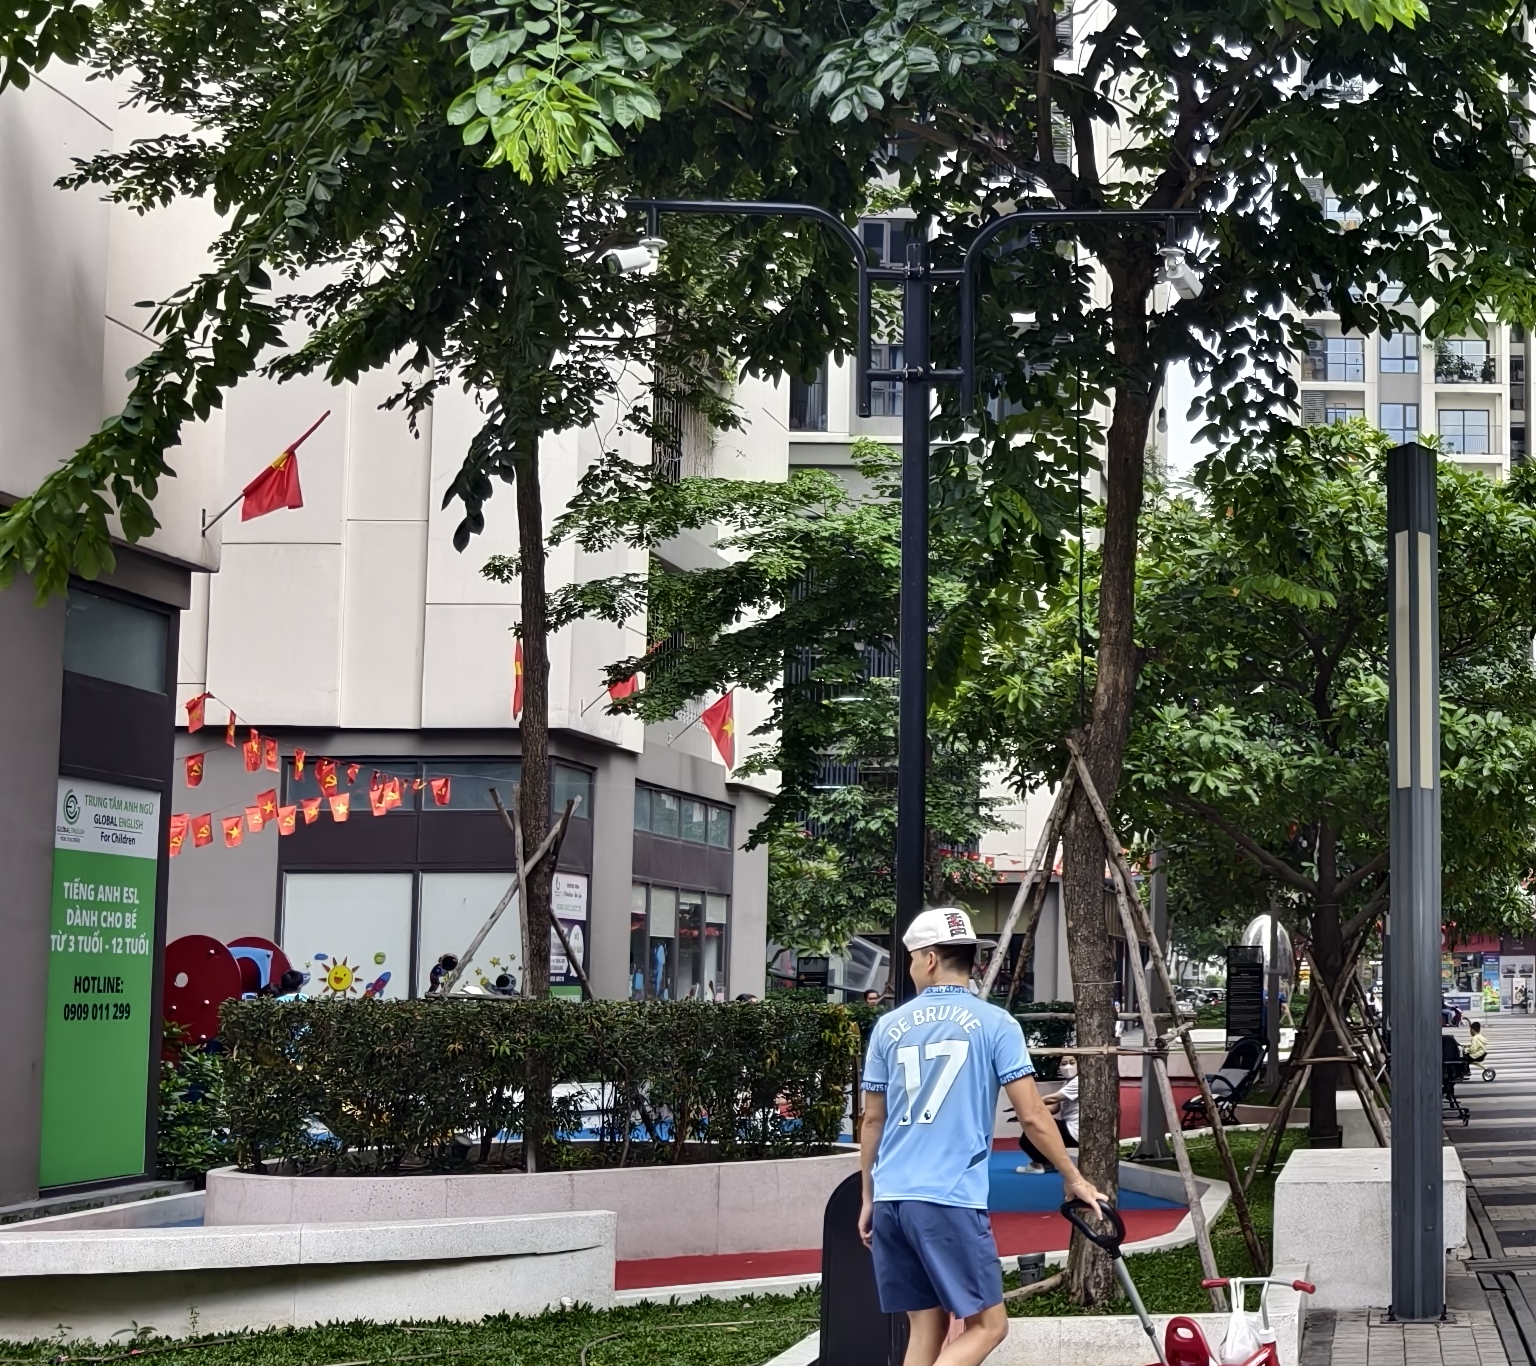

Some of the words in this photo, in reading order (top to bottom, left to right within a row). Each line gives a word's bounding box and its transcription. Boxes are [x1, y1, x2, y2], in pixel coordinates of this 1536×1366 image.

[85, 795, 108, 809] TRUNG
[108, 796, 123, 811] TÂM
[123, 802, 139, 813] ANH
[94, 814, 117, 827] GLOBAL
[118, 817, 144, 830] ENGLISH
[100, 832, 111, 843] For
[111, 833, 136, 846] Children
[63, 877, 95, 902] TIẾNG
[97, 884, 121, 903] ANH
[123, 886, 140, 905] ESL
[66, 904, 98, 928] DÀNH
[100, 910, 123, 929] CHO
[125, 908, 138, 929] BÉ
[50, 930, 67, 952] TỪ
[68, 935, 75, 953] 3
[77, 930, 103, 954] TUỔI
[112, 937, 123, 954] 12
[125, 932, 149, 956] TUỔI
[73, 976, 124, 994] HOTLINE:
[63, 1003, 89, 1021] 0909
[91, 1003, 110, 1021] 011
[112, 1002, 131, 1021] 299
[888, 1017, 911, 1042] DE
[912, 1005, 982, 1035] BRUYNE
[896, 1038, 970, 1126] 17
